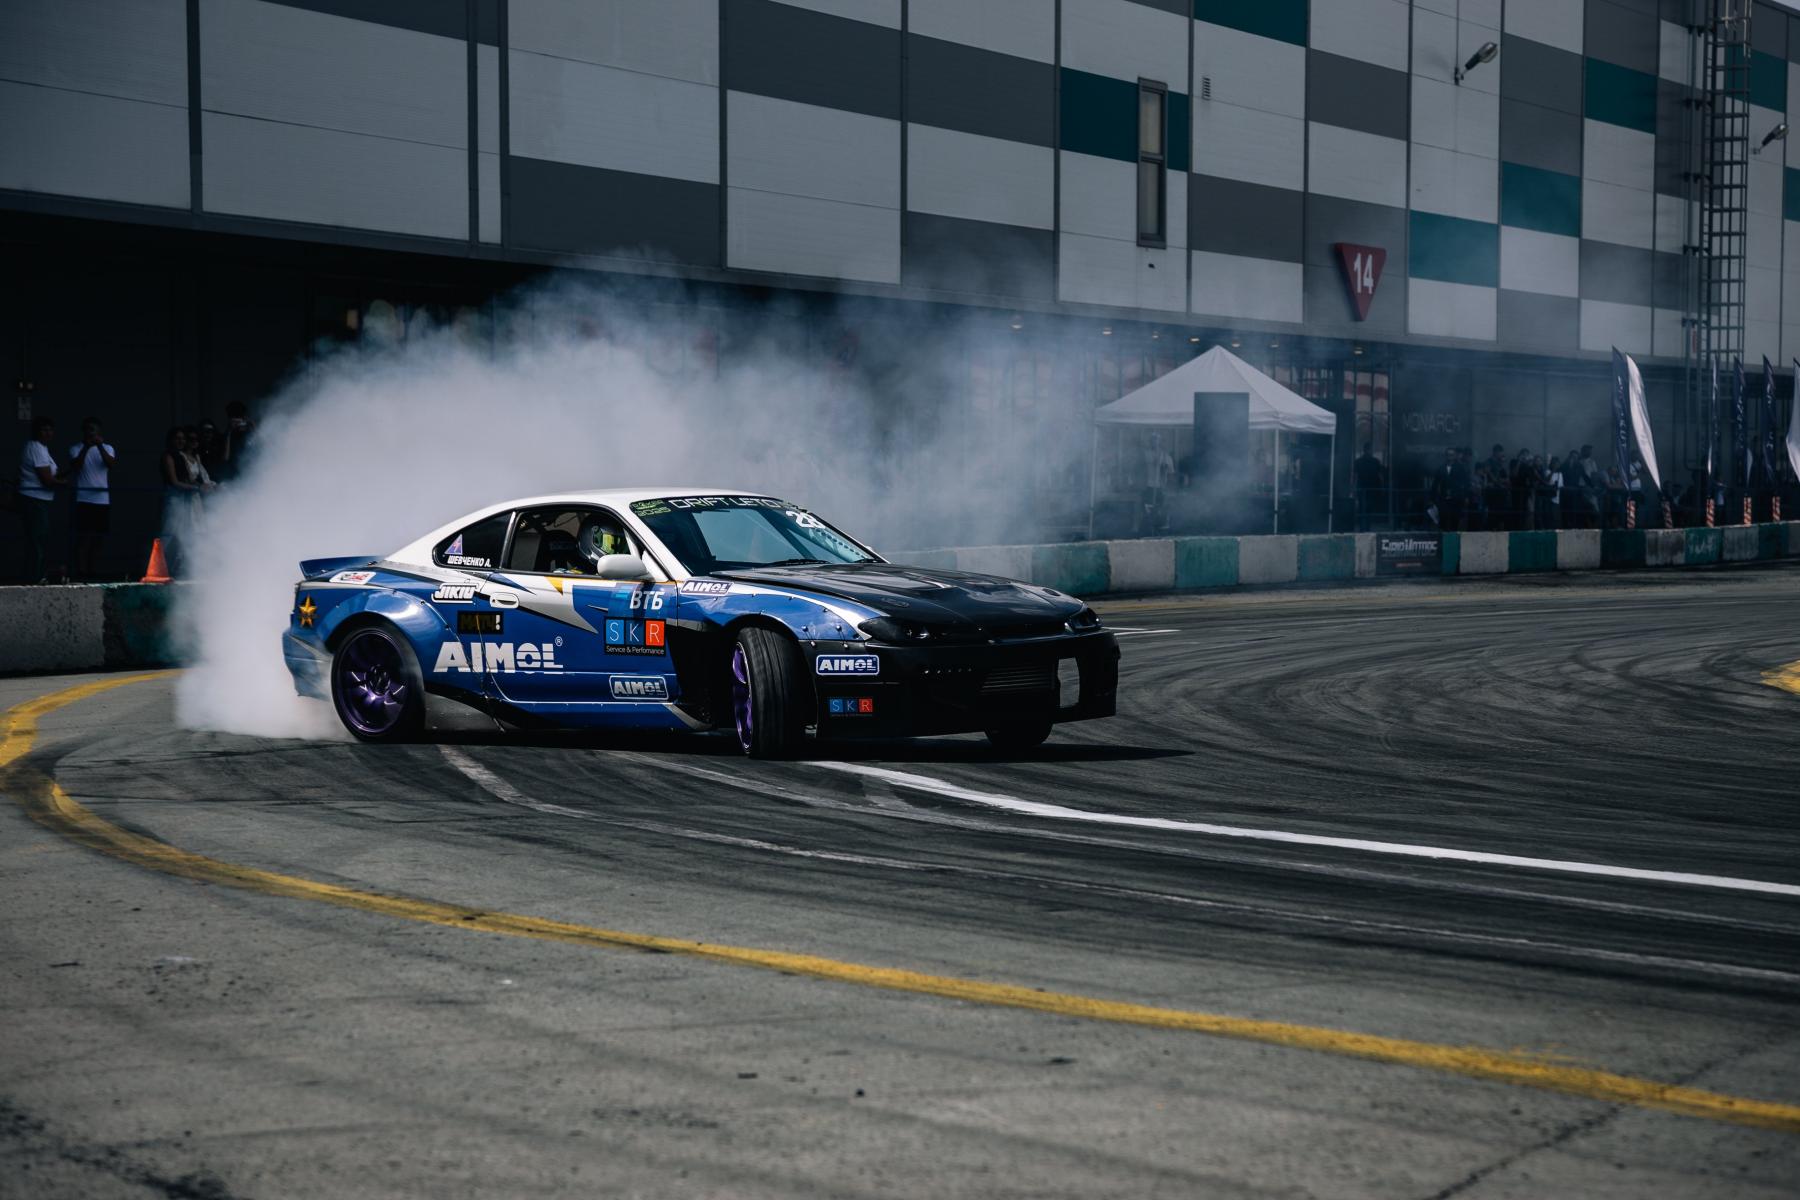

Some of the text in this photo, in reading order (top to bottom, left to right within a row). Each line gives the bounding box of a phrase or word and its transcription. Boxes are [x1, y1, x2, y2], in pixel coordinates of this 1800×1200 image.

[1353, 252, 1375, 295] 14
[668, 497, 729, 509] DRIFT
[447, 555, 485, 567] ШЕВЧЕНКО
[682, 581, 730, 593] AIMOL
[629, 590, 665, 610] ВТБ
[606, 645, 626, 653] Service
